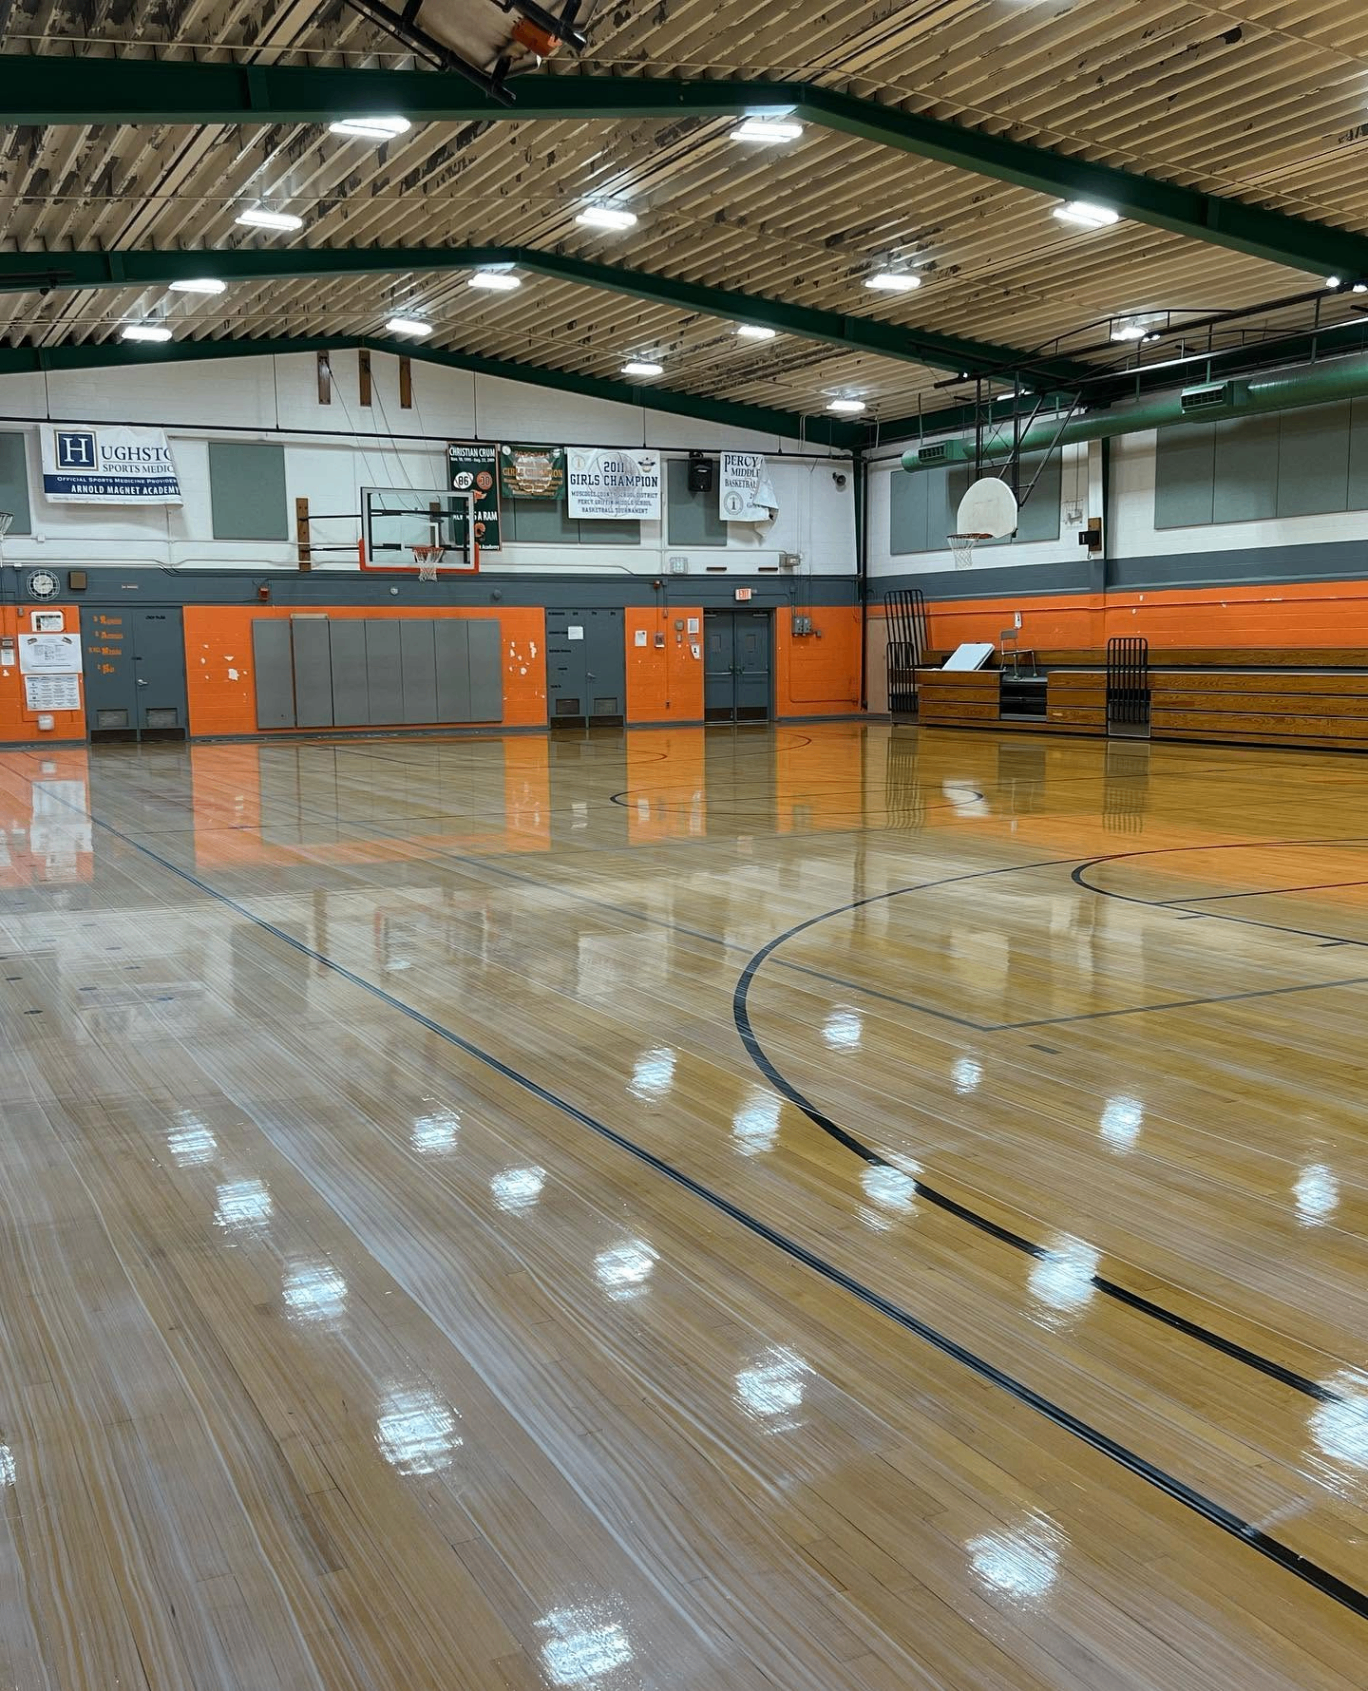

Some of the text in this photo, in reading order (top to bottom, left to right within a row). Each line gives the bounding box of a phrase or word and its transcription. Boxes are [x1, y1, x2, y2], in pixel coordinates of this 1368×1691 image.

[449, 447, 478, 457] CHRISTIAN
[103, 463, 140, 473] SPORTS
[604, 461, 624, 473] 2011
[724, 454, 758, 472] PERCY
[458, 475, 469, 486] 86
[570, 473, 600, 485] GIRLS
[603, 475, 658, 487] CHAMPION
[71, 484, 104, 494] ARNOLD
[106, 485, 140, 494] MAGNET
[478, 511, 482, 521] A
[483, 511, 498, 521] RAM
